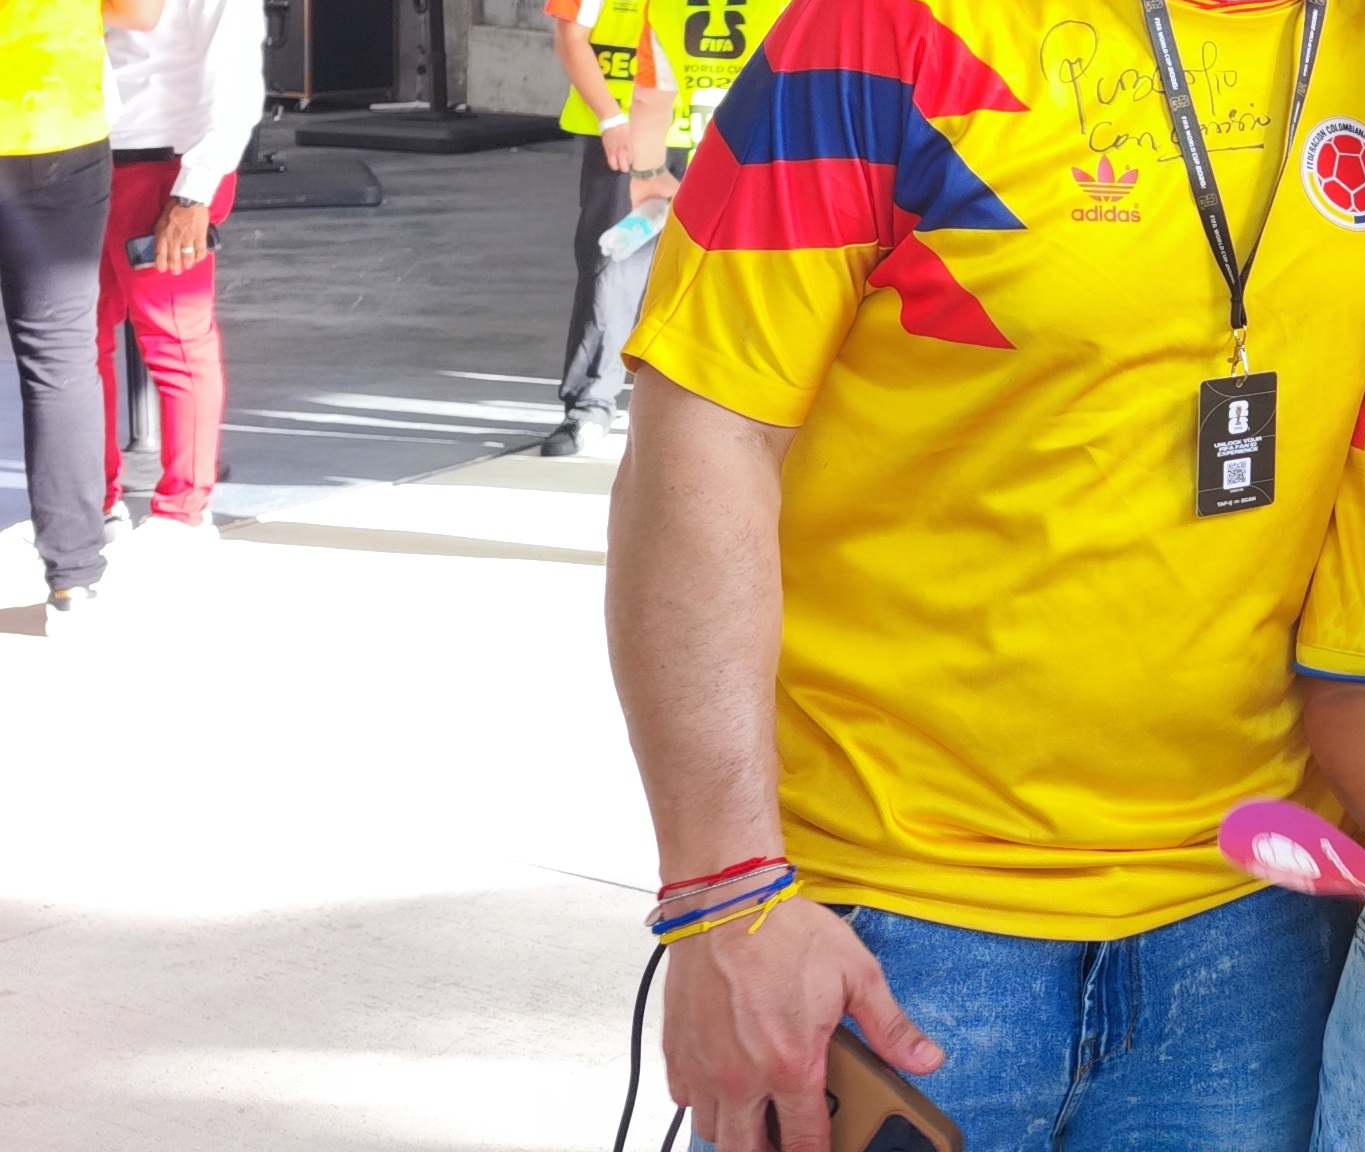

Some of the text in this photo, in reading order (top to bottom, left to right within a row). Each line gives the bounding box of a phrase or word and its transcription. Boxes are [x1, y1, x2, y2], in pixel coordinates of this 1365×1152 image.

[700, 38, 734, 52] FIFA
[685, 76, 730, 88] 202
[1071, 206, 1141, 222] adidas
[1221, 250, 1229, 263] CUP
